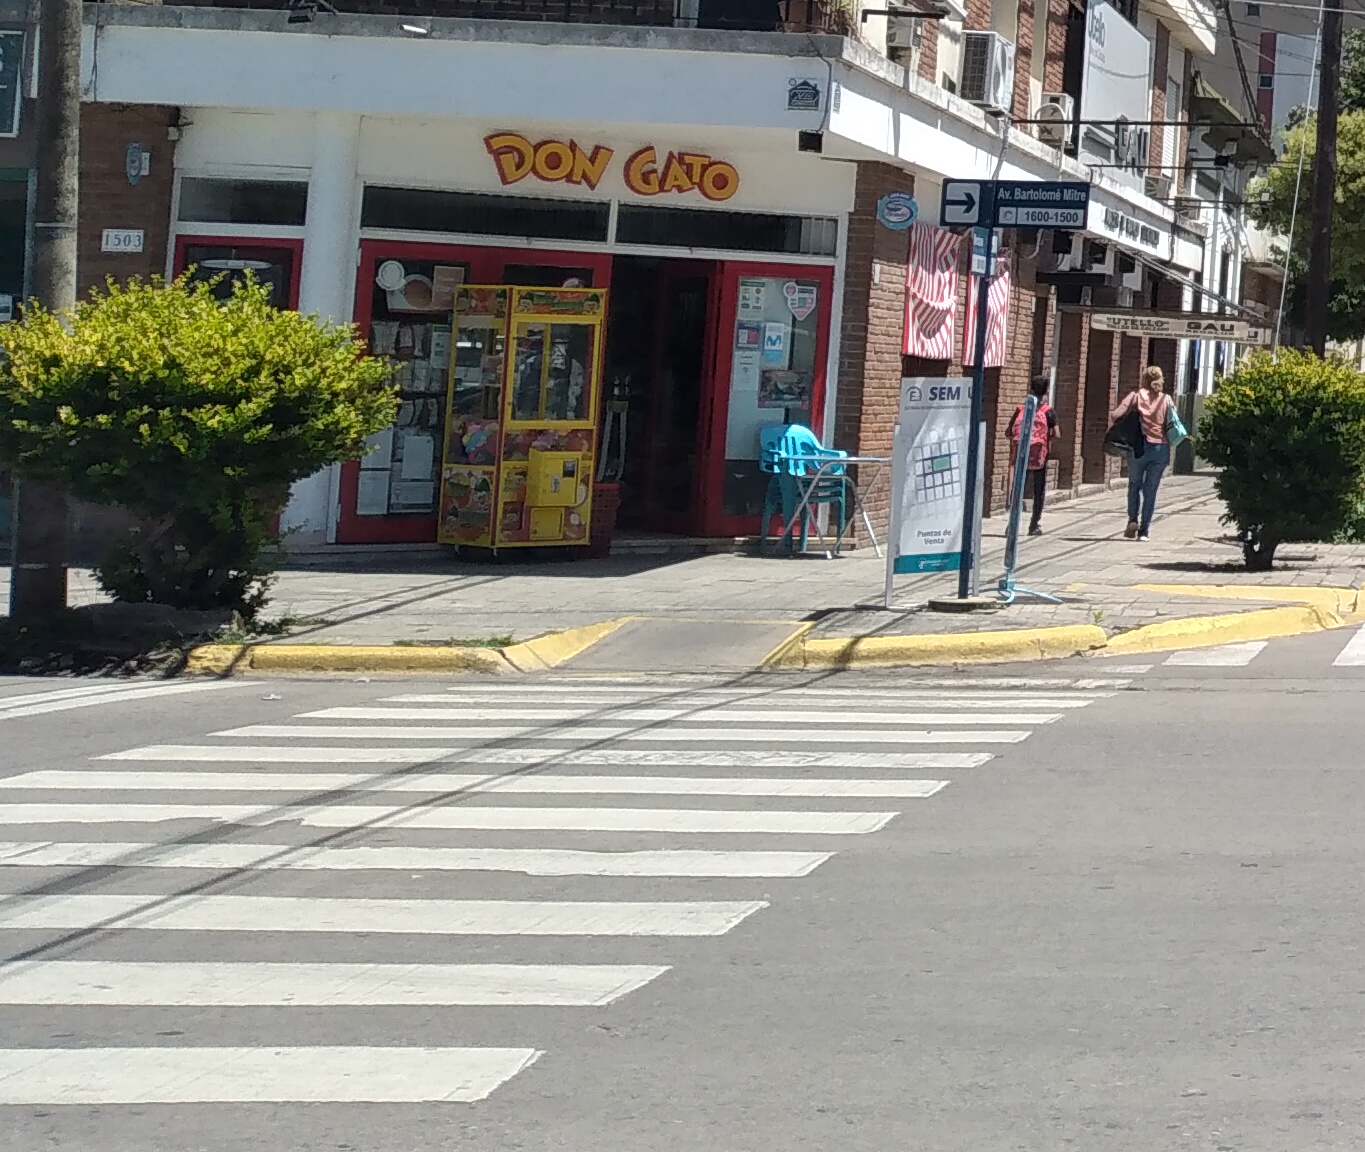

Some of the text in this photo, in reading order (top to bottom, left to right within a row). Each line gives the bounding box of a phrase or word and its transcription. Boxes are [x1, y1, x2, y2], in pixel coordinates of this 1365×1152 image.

[483, 132, 740, 201] DON GATO
[997, 187, 1087, 202] Av. Bartolomé Mitre
[1024, 210, 1079, 223] 1600-1500
[104, 233, 142, 247] 1503
[1187, 321, 1235, 332] GAU
[928, 386, 961, 401] SEM
[917, 530, 942, 538] Puntos
